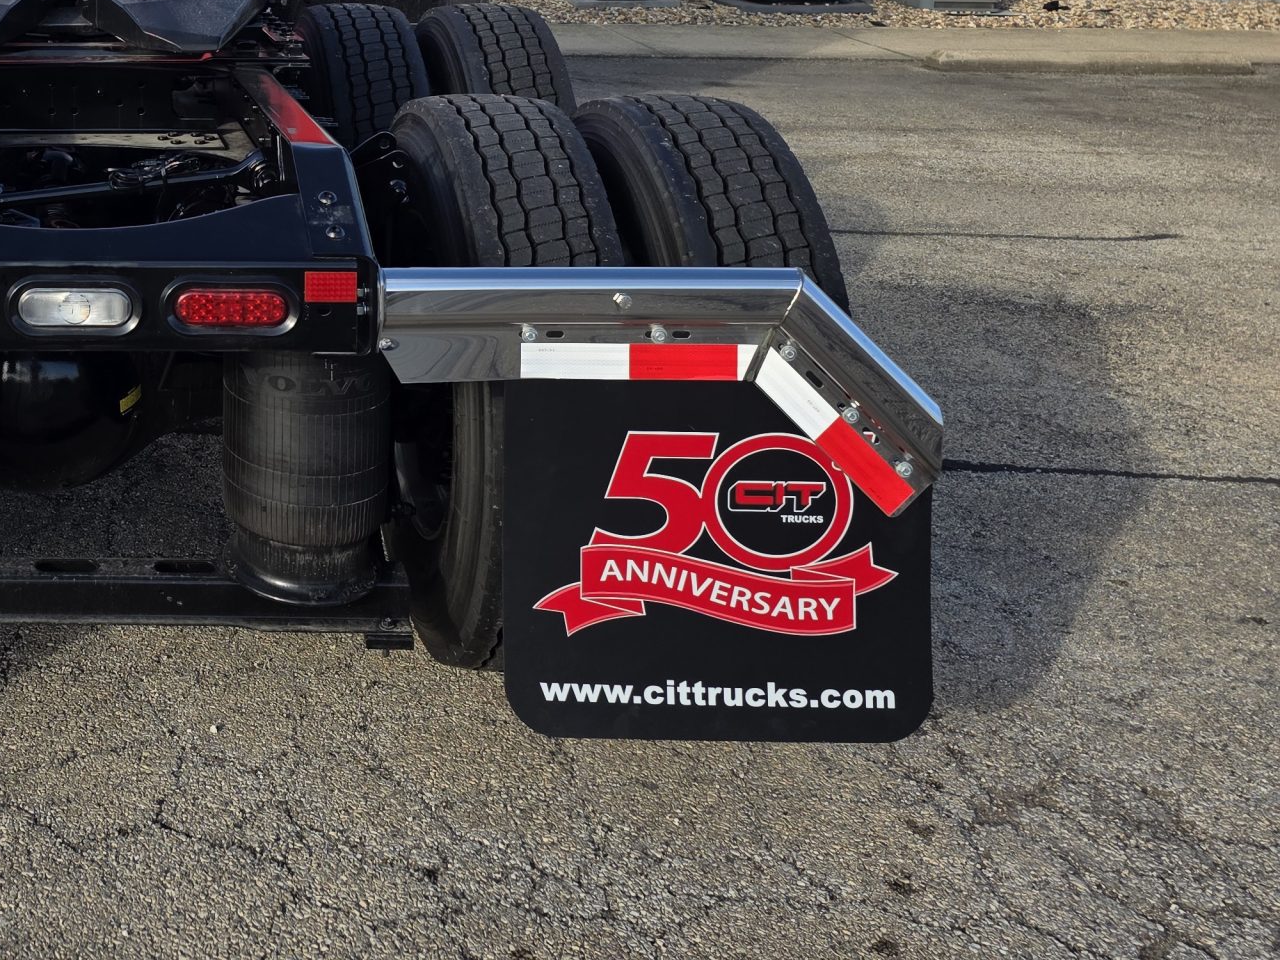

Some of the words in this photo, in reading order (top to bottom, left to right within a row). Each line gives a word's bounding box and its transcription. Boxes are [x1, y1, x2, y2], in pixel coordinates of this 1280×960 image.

[728, 480, 826, 512] CIT
[780, 514, 824, 524] TRUCKS
[600, 559, 841, 621] ANNIVERSARY
[539, 681, 896, 709] www.cittrucks.com
